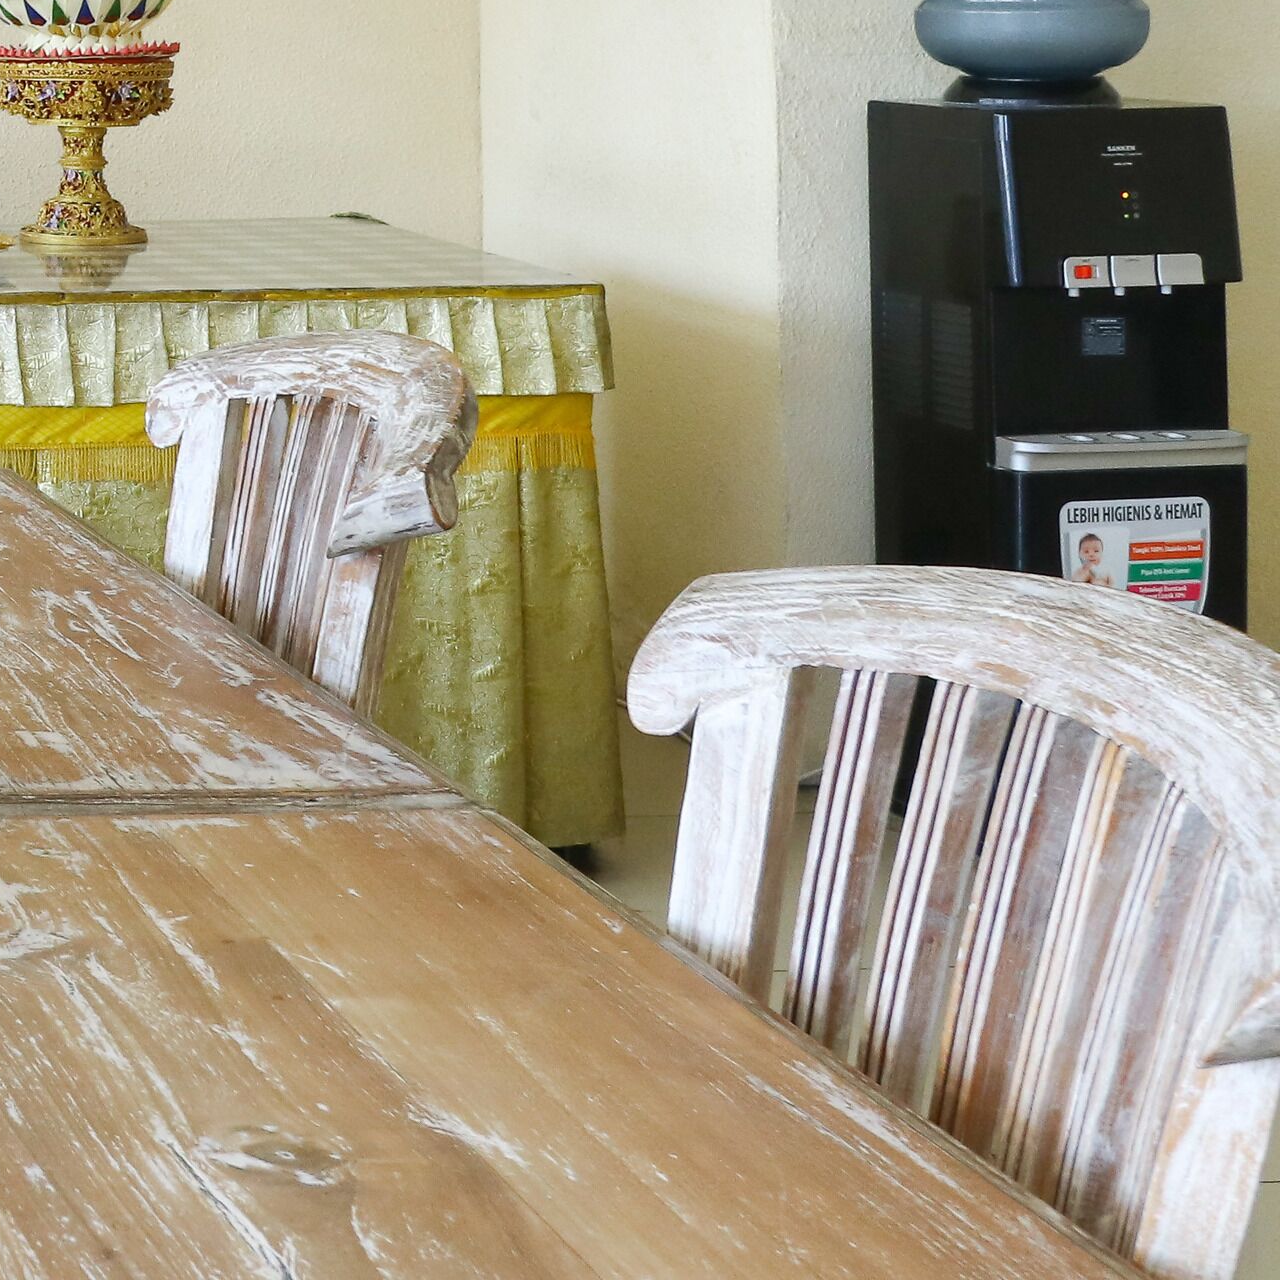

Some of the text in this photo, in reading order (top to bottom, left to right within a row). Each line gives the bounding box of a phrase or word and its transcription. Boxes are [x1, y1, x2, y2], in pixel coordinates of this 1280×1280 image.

[1067, 503, 1203, 524] LEBIH HIGIENIS & HEMAT
